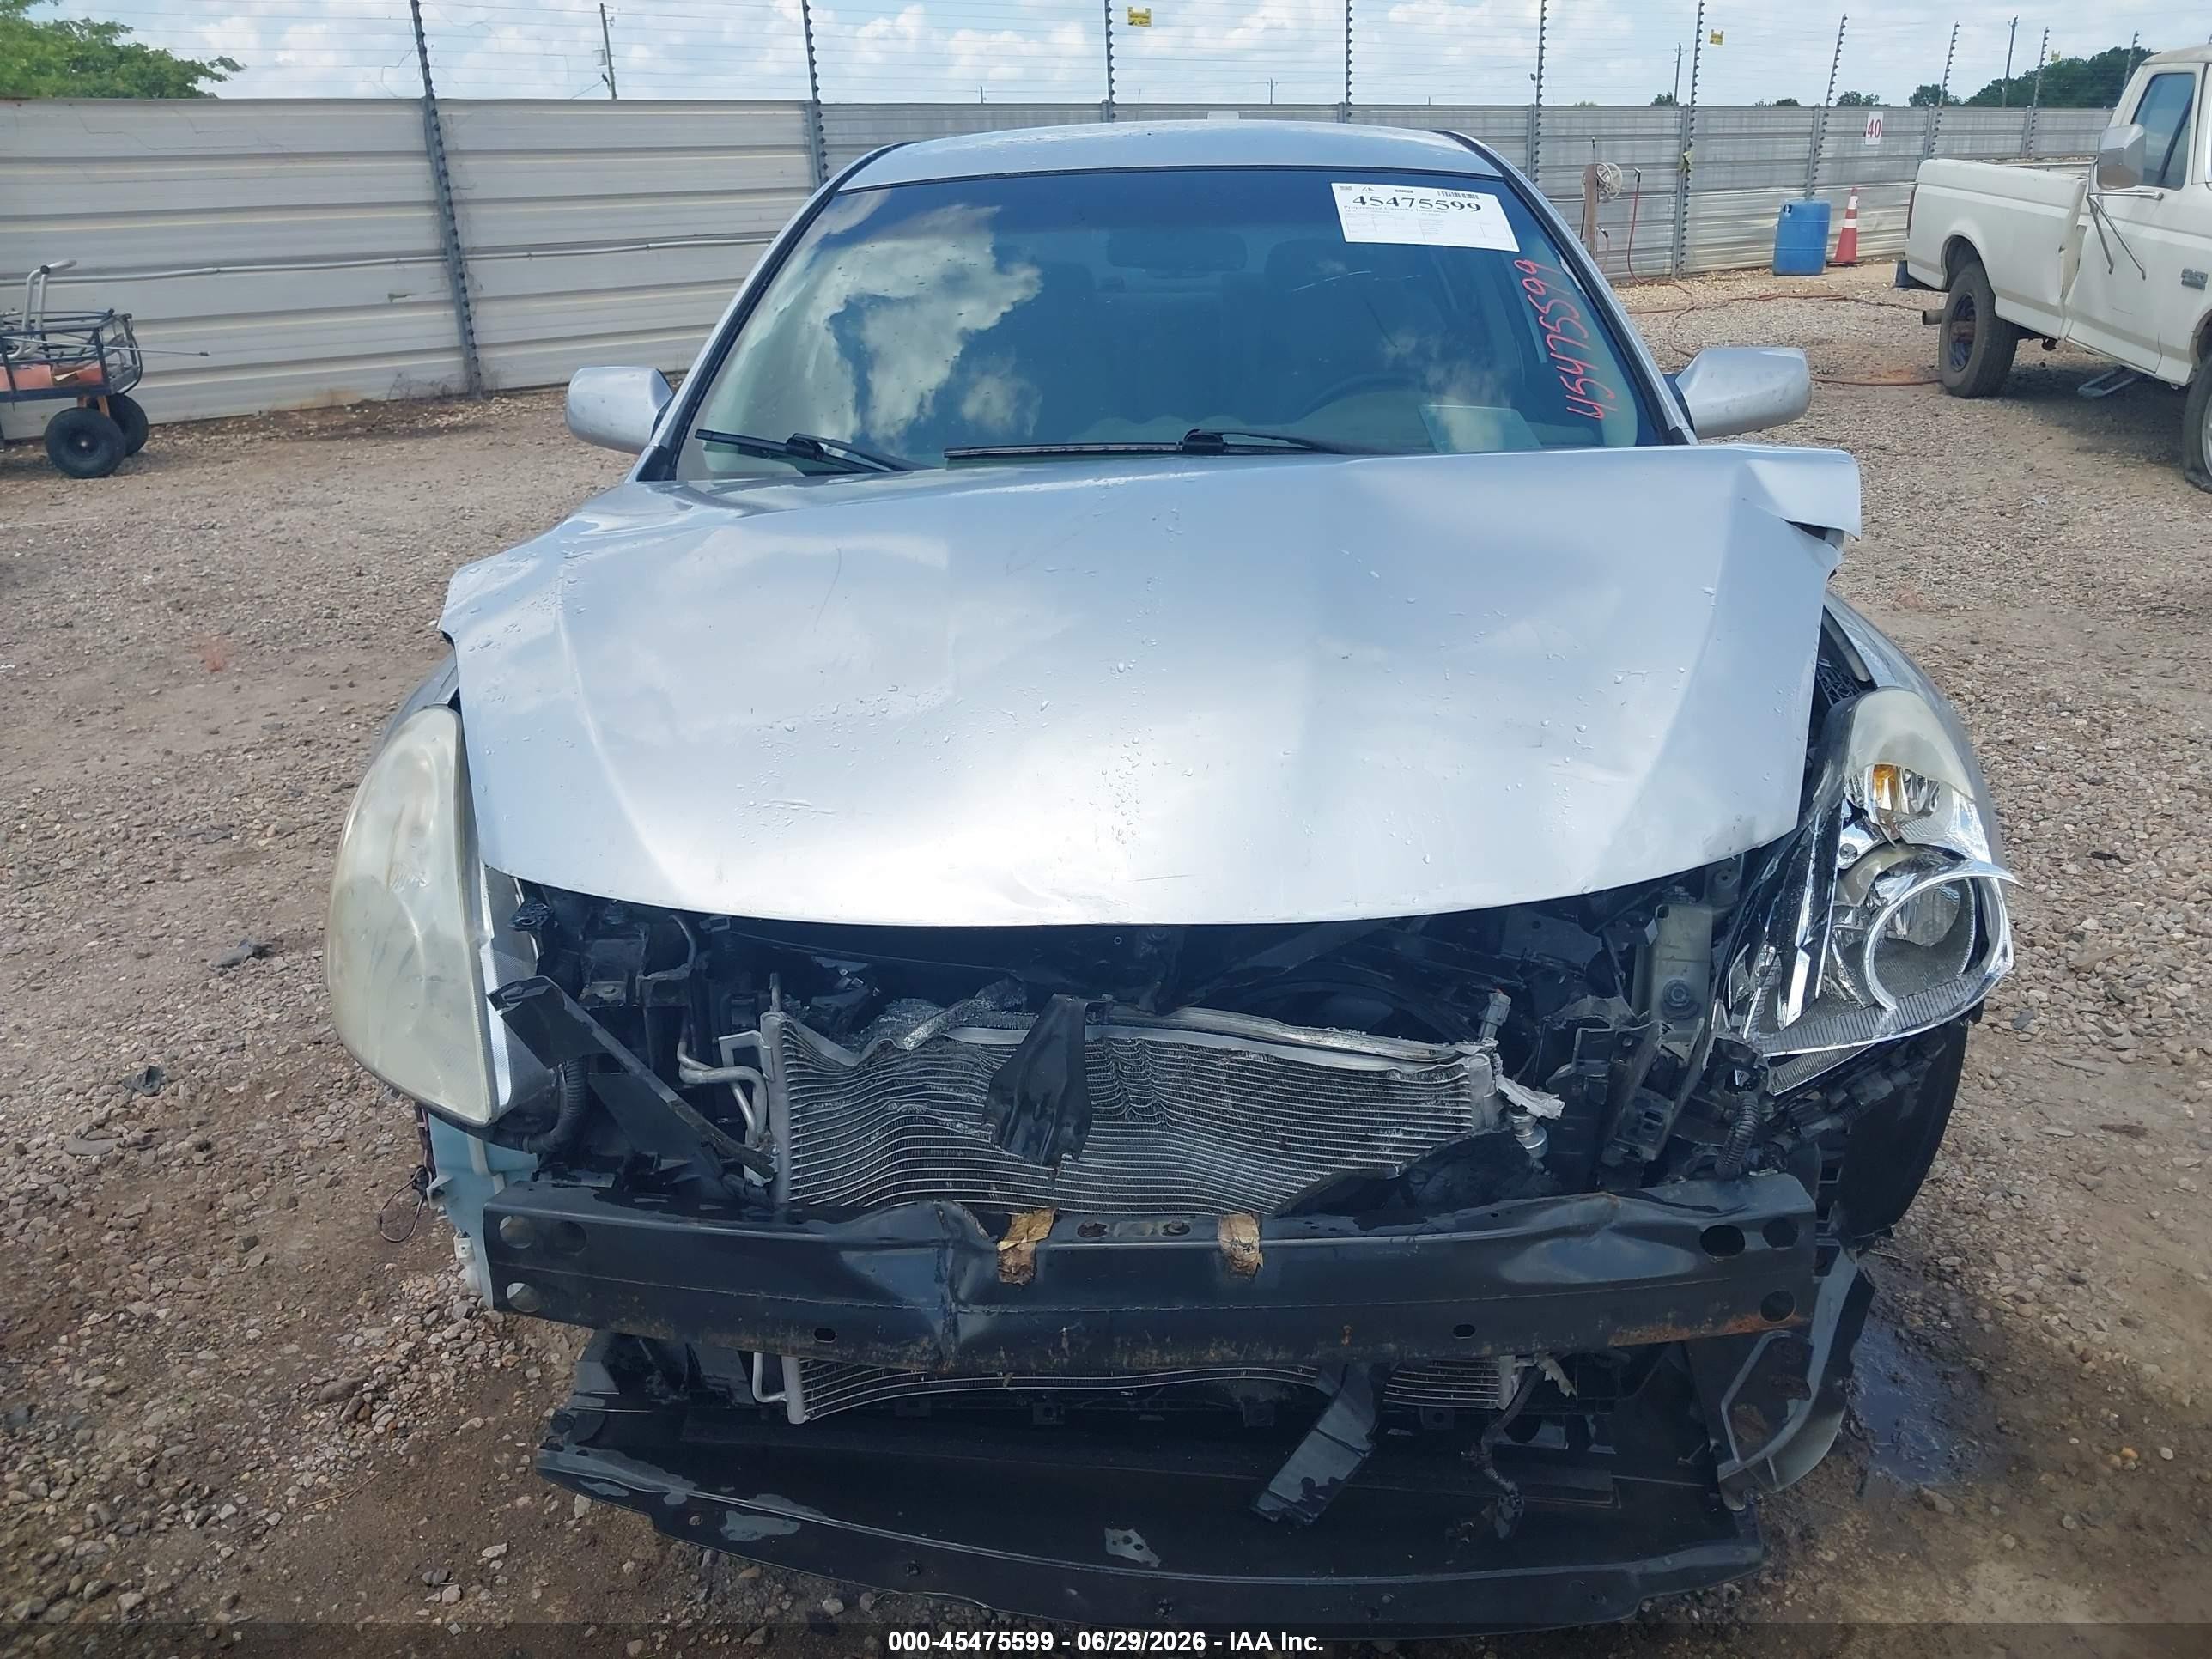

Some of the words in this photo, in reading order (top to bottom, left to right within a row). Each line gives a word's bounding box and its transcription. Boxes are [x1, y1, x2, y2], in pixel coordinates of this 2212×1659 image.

[1867, 118, 1881, 138] 40
[1352, 195, 1482, 213] 45475599
[1513, 258, 1619, 420] 45475599
